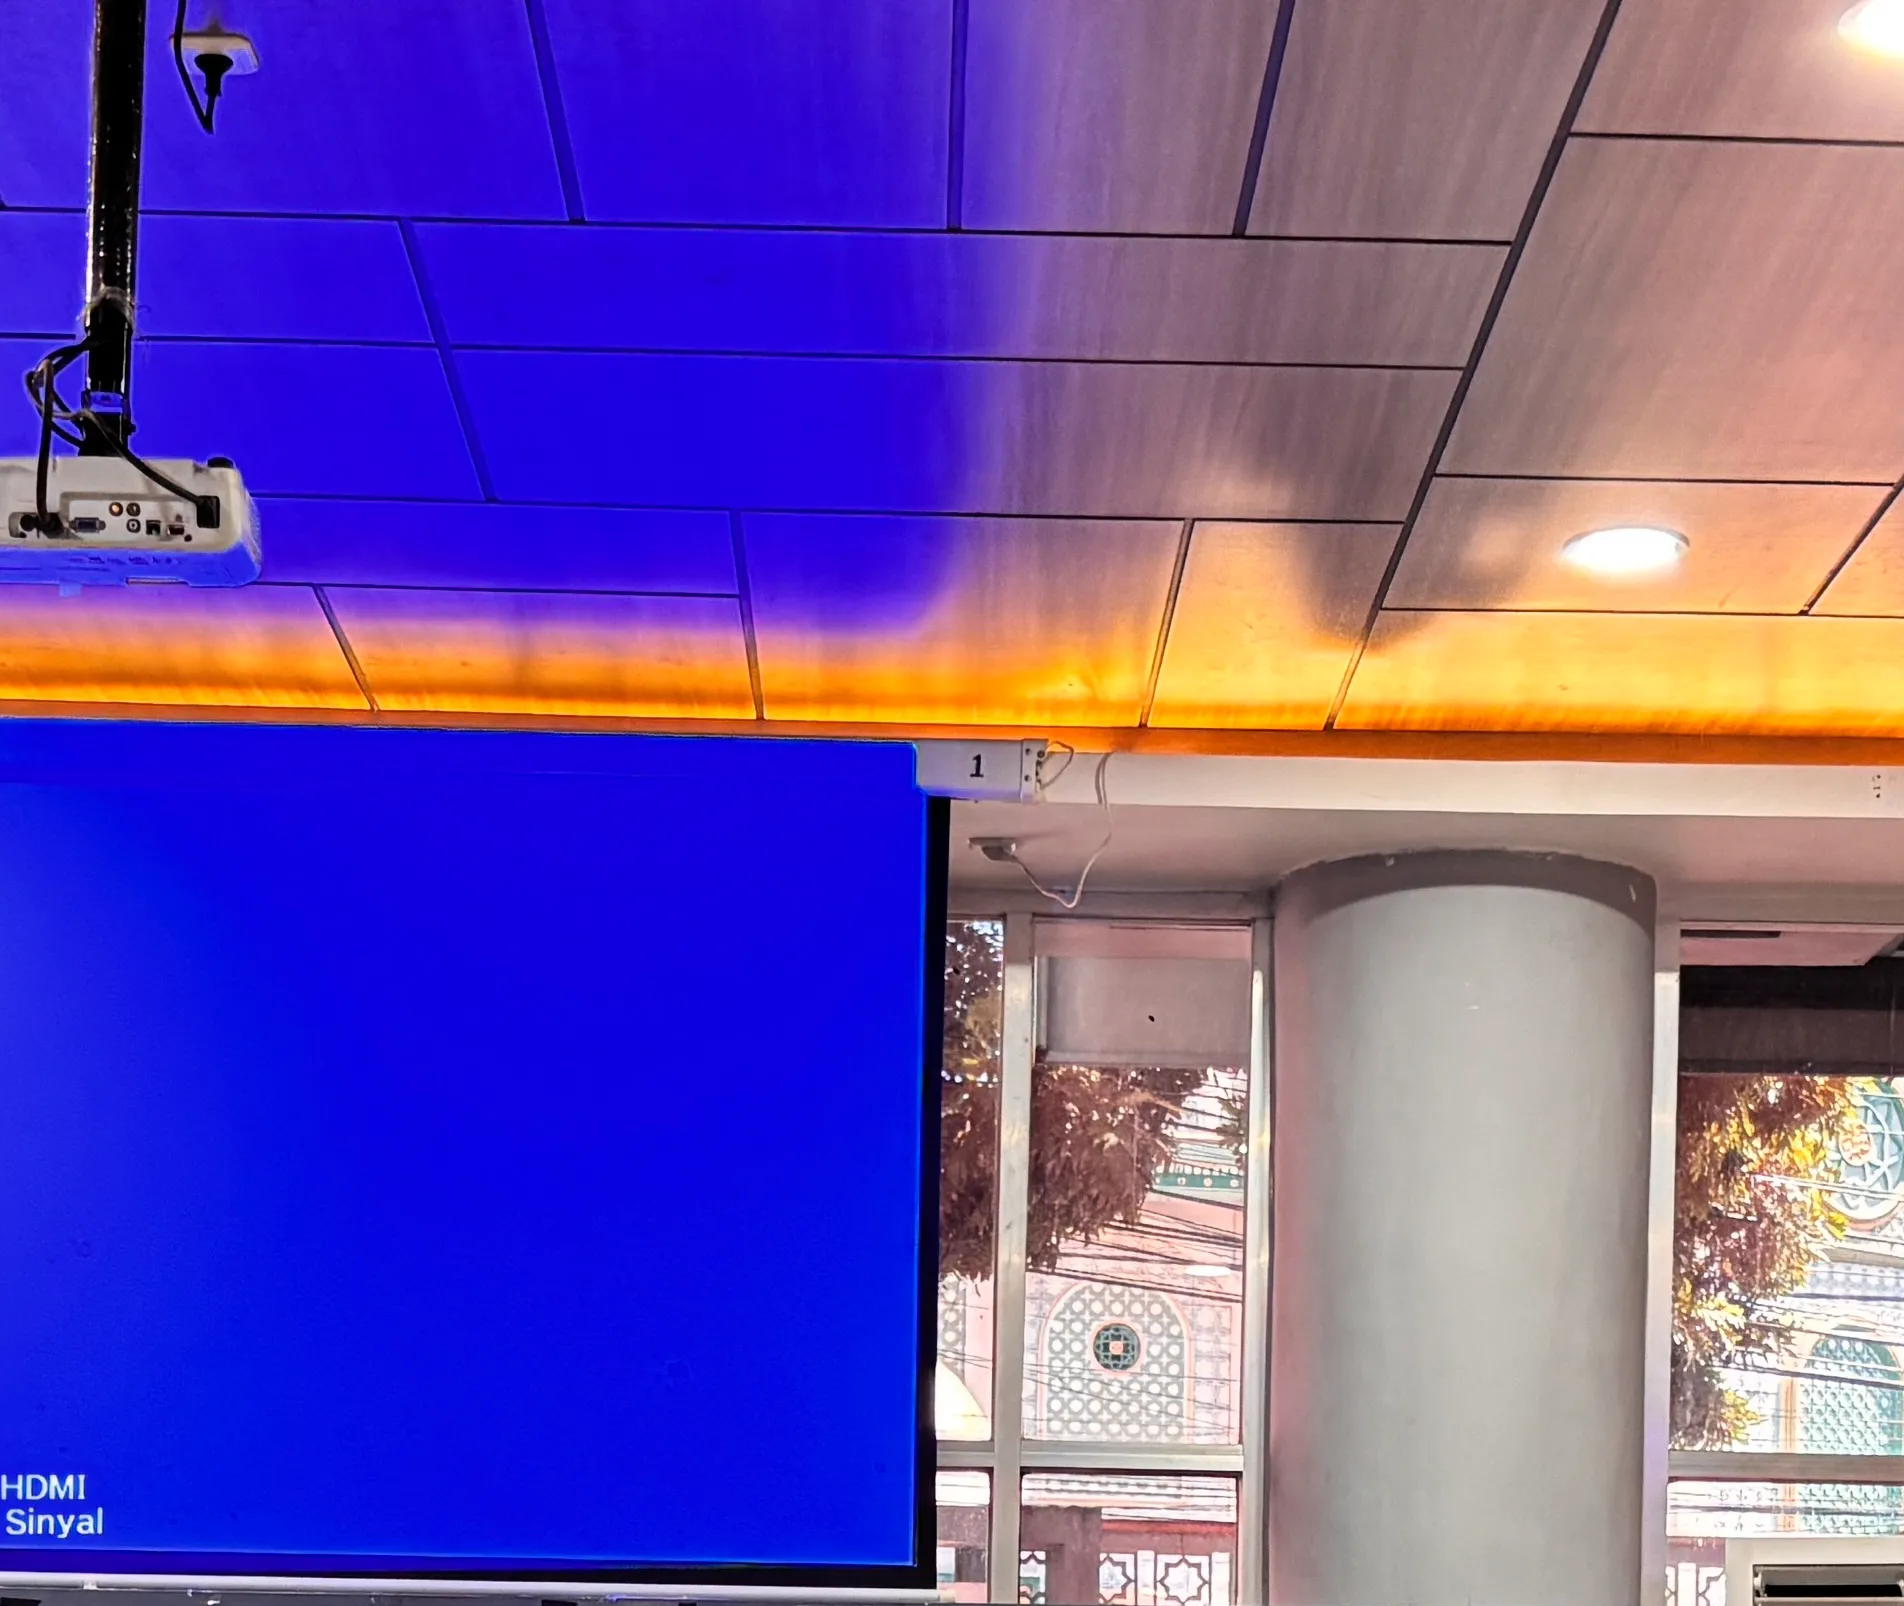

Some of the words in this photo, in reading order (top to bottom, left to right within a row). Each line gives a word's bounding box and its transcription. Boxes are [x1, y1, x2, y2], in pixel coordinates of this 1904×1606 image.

[970, 754, 984, 777] 1
[1, 1474, 86, 1500] HDMI
[6, 1506, 103, 1538] Sinyal
